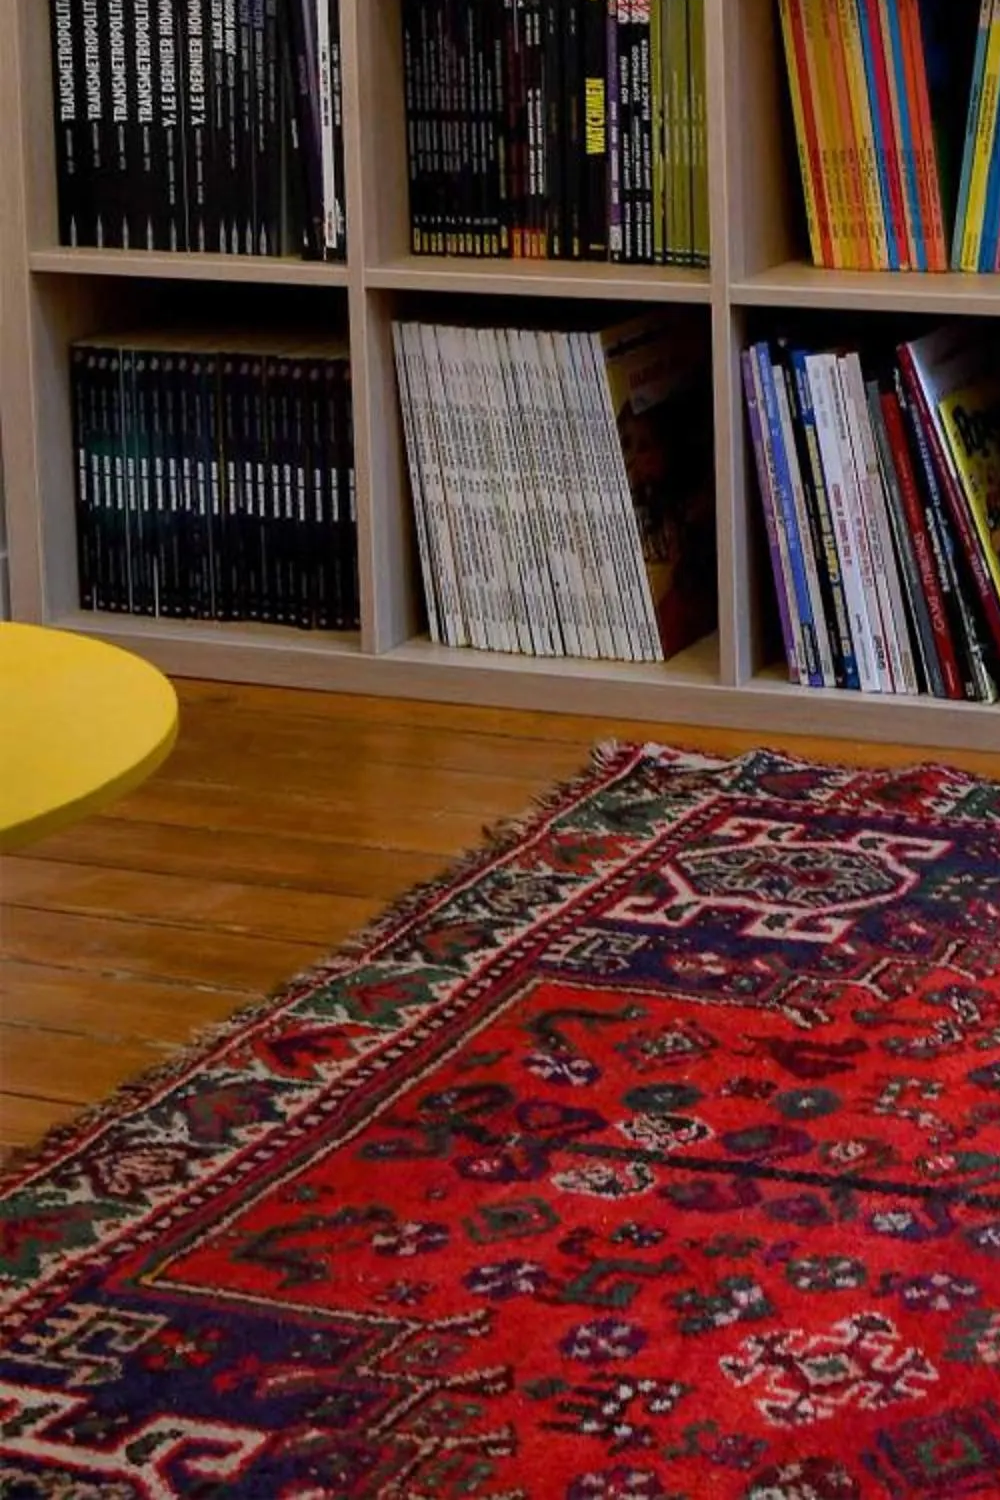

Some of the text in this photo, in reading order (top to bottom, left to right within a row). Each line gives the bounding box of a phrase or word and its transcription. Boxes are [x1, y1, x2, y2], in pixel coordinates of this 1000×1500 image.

[160, 39, 175, 92] DERNIER
[189, 38, 204, 93] DERNIER
[631, 45, 640, 102] SUPERGOD
[162, 95, 176, 111] LE
[190, 95, 205, 111] LE
[585, 78, 605, 155] WATCHMEN
[621, 87, 629, 104] NO
